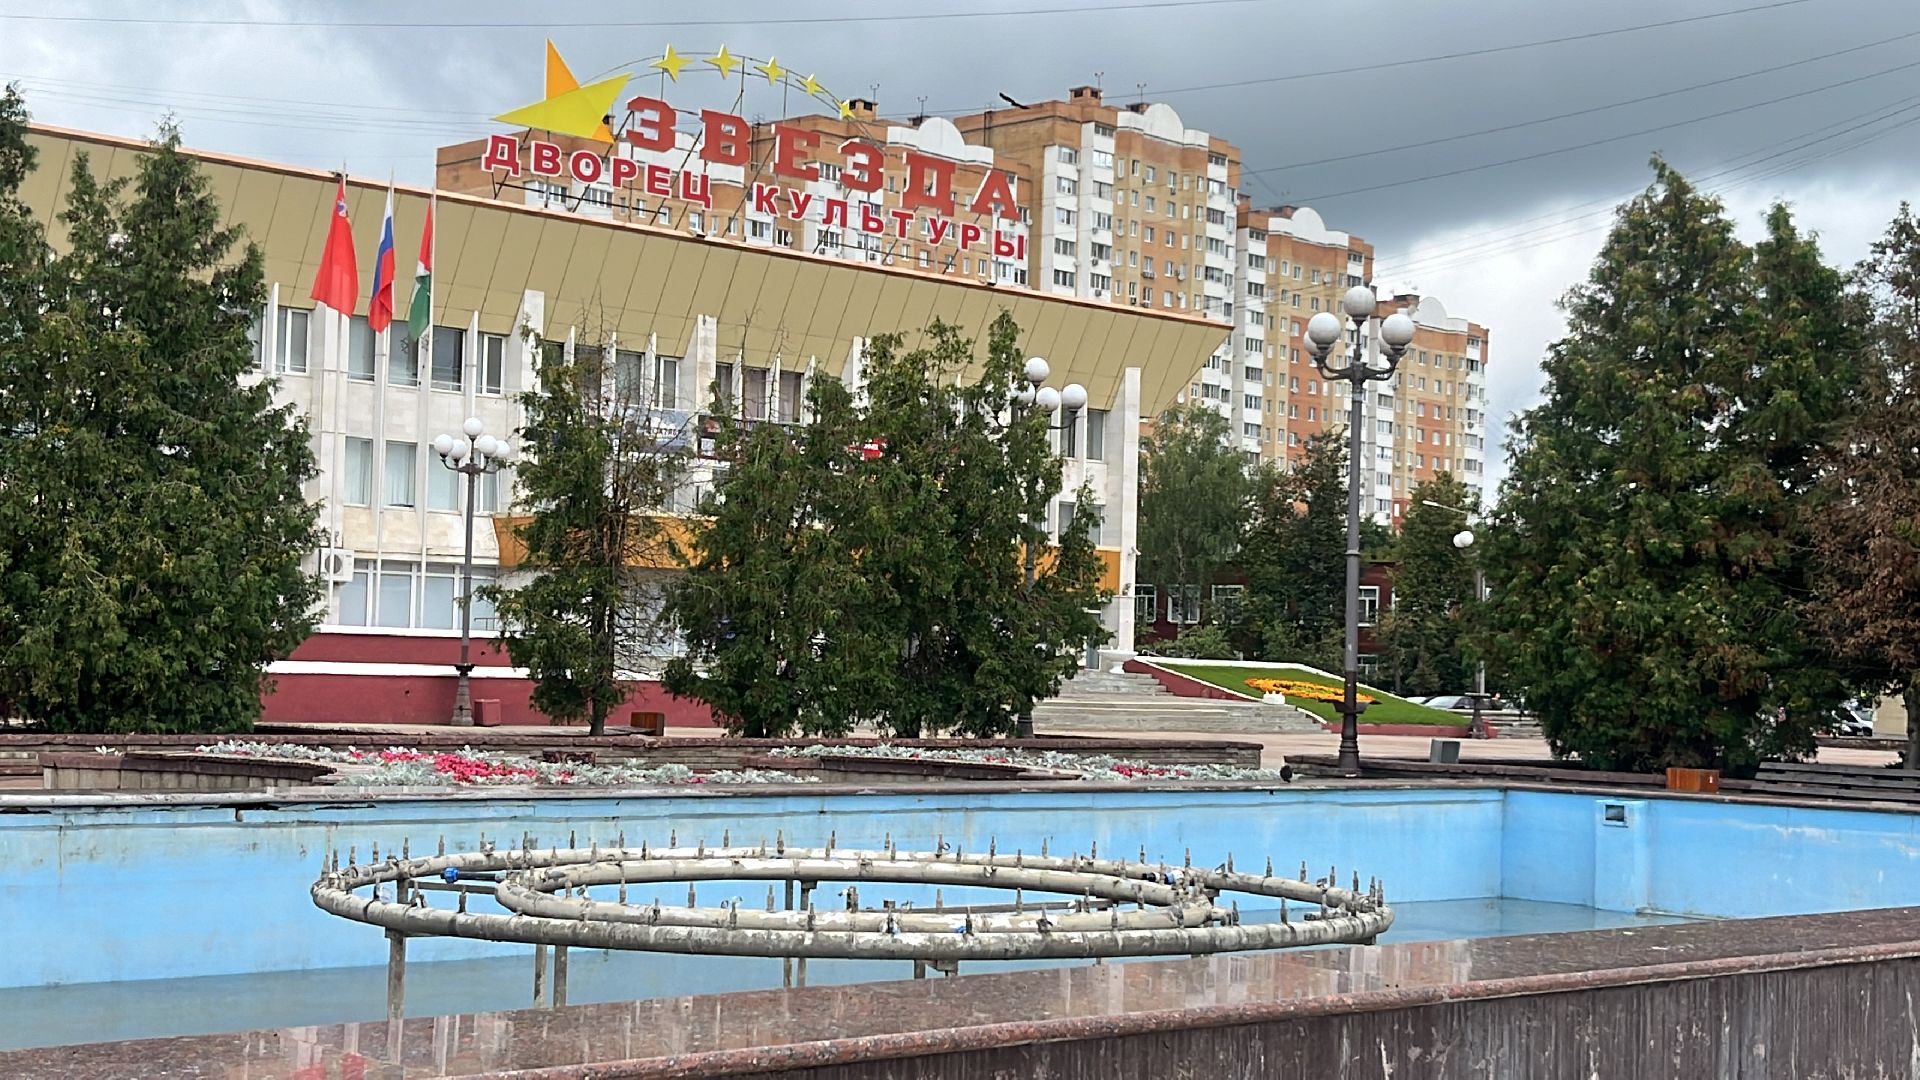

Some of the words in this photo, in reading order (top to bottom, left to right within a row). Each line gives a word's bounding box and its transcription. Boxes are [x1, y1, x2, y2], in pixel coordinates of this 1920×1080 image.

[482, 134, 712, 210] ДВОРЕЦ
[753, 182, 1027, 260] КУЛЬТУРЫ
[626, 97, 1019, 219] ЗВЕЗДА
